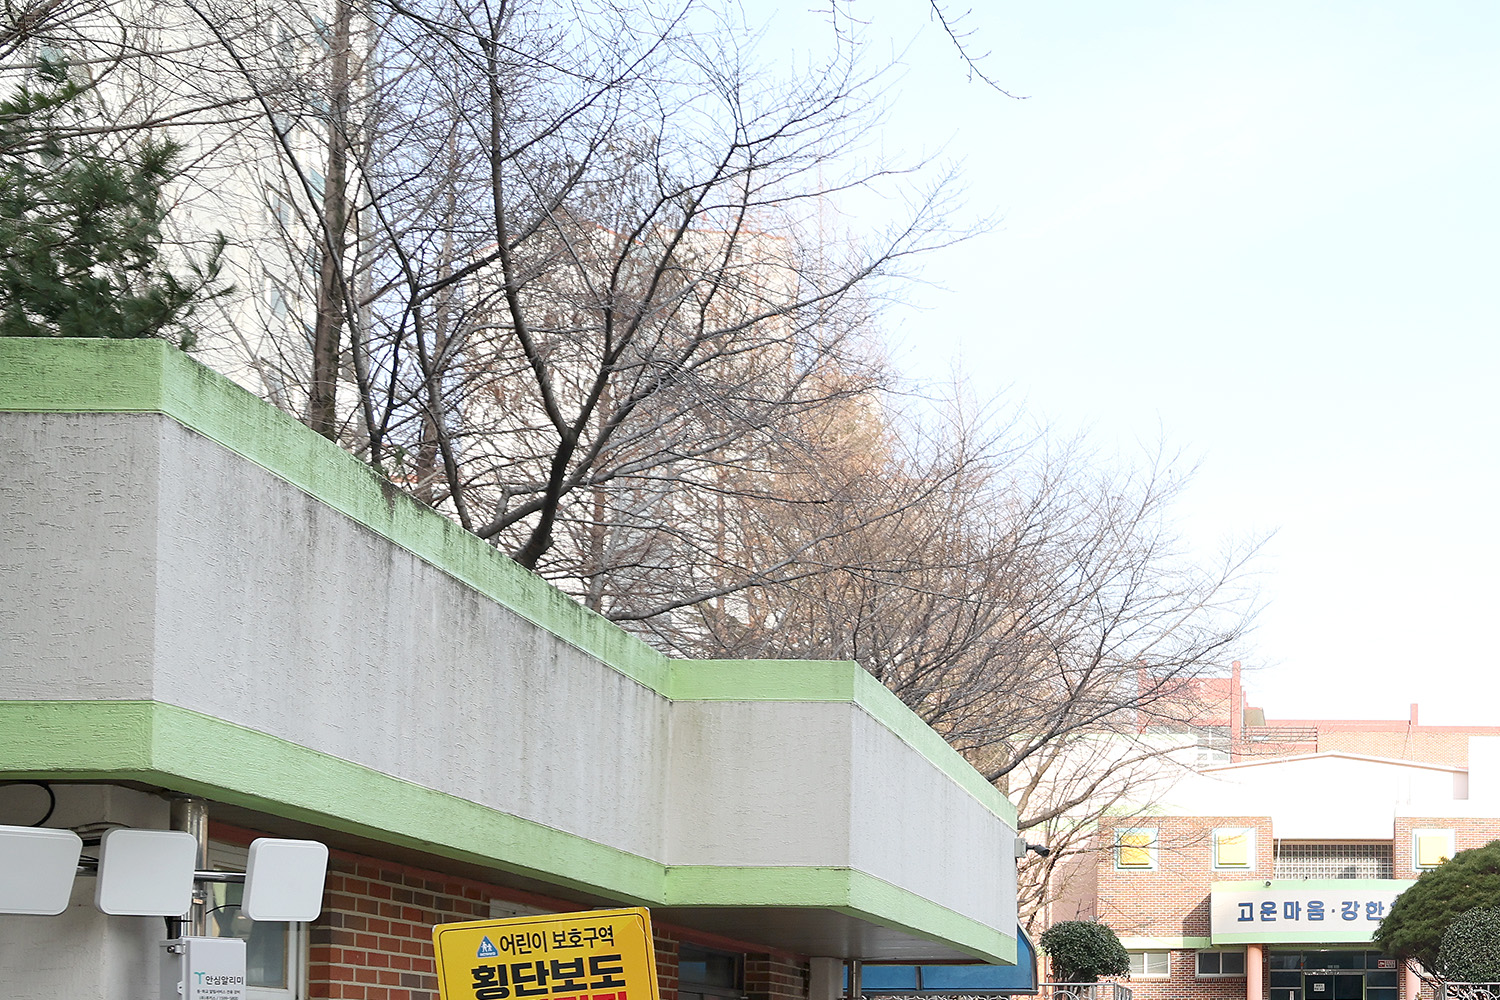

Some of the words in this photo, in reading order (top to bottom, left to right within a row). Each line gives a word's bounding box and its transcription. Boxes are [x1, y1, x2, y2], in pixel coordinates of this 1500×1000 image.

[499, 930, 548, 956] 어린이
[552, 924, 615, 950] 보호구역
[205, 975, 244, 986] 안심알리미
[471, 953, 626, 1000] 횡단보도
